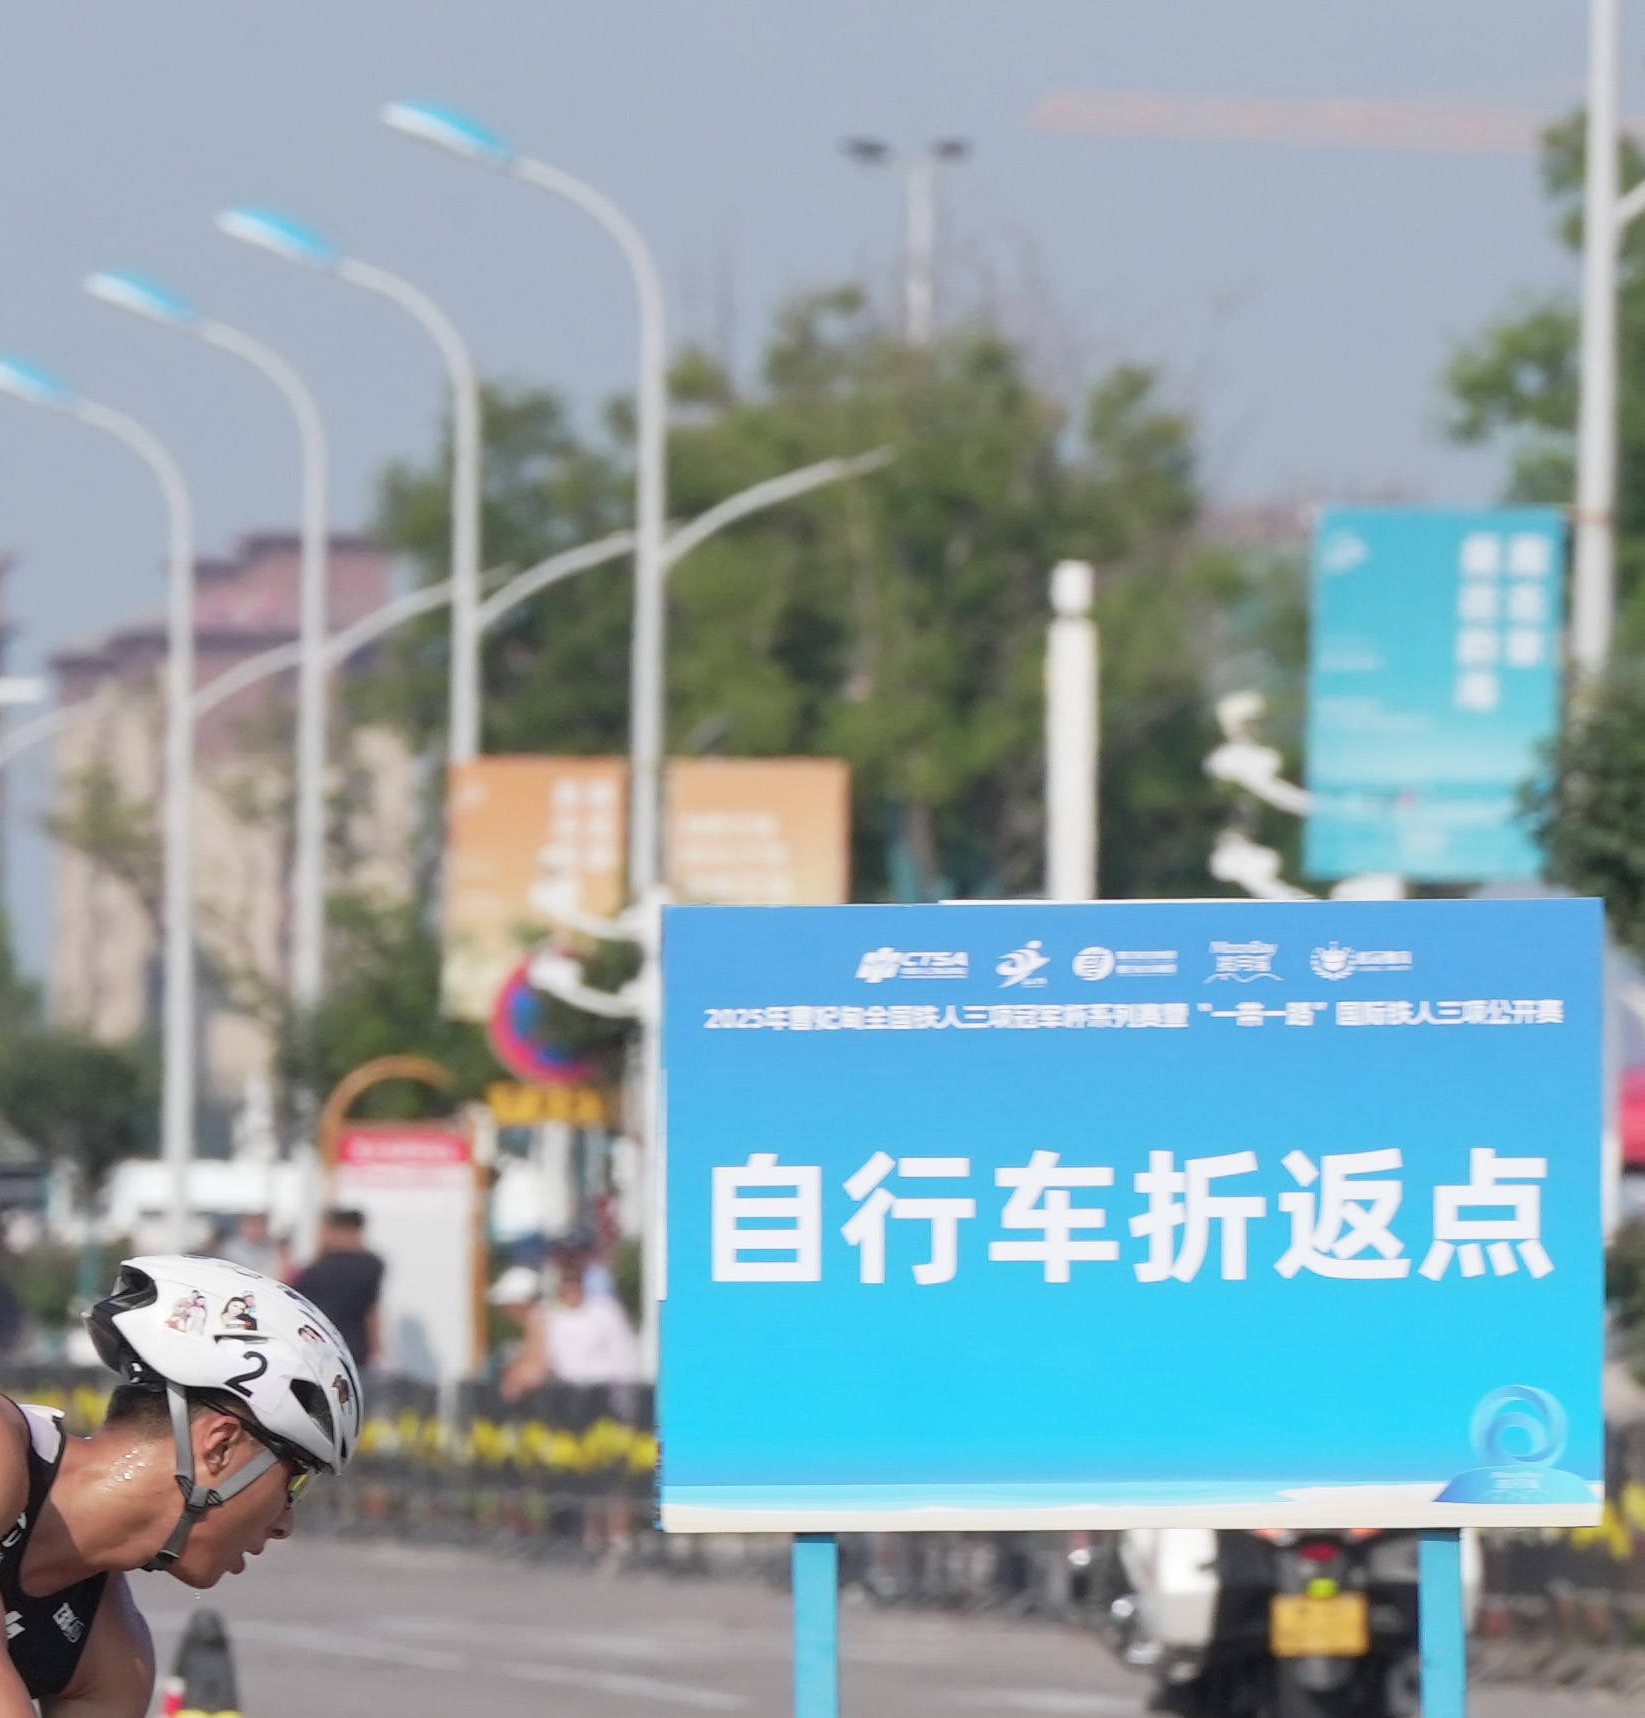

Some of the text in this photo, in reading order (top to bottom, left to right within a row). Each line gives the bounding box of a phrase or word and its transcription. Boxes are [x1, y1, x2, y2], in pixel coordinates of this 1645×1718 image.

[710, 1147, 1555, 1285] 自行车折返点
[224, 1350, 268, 1398] 2
